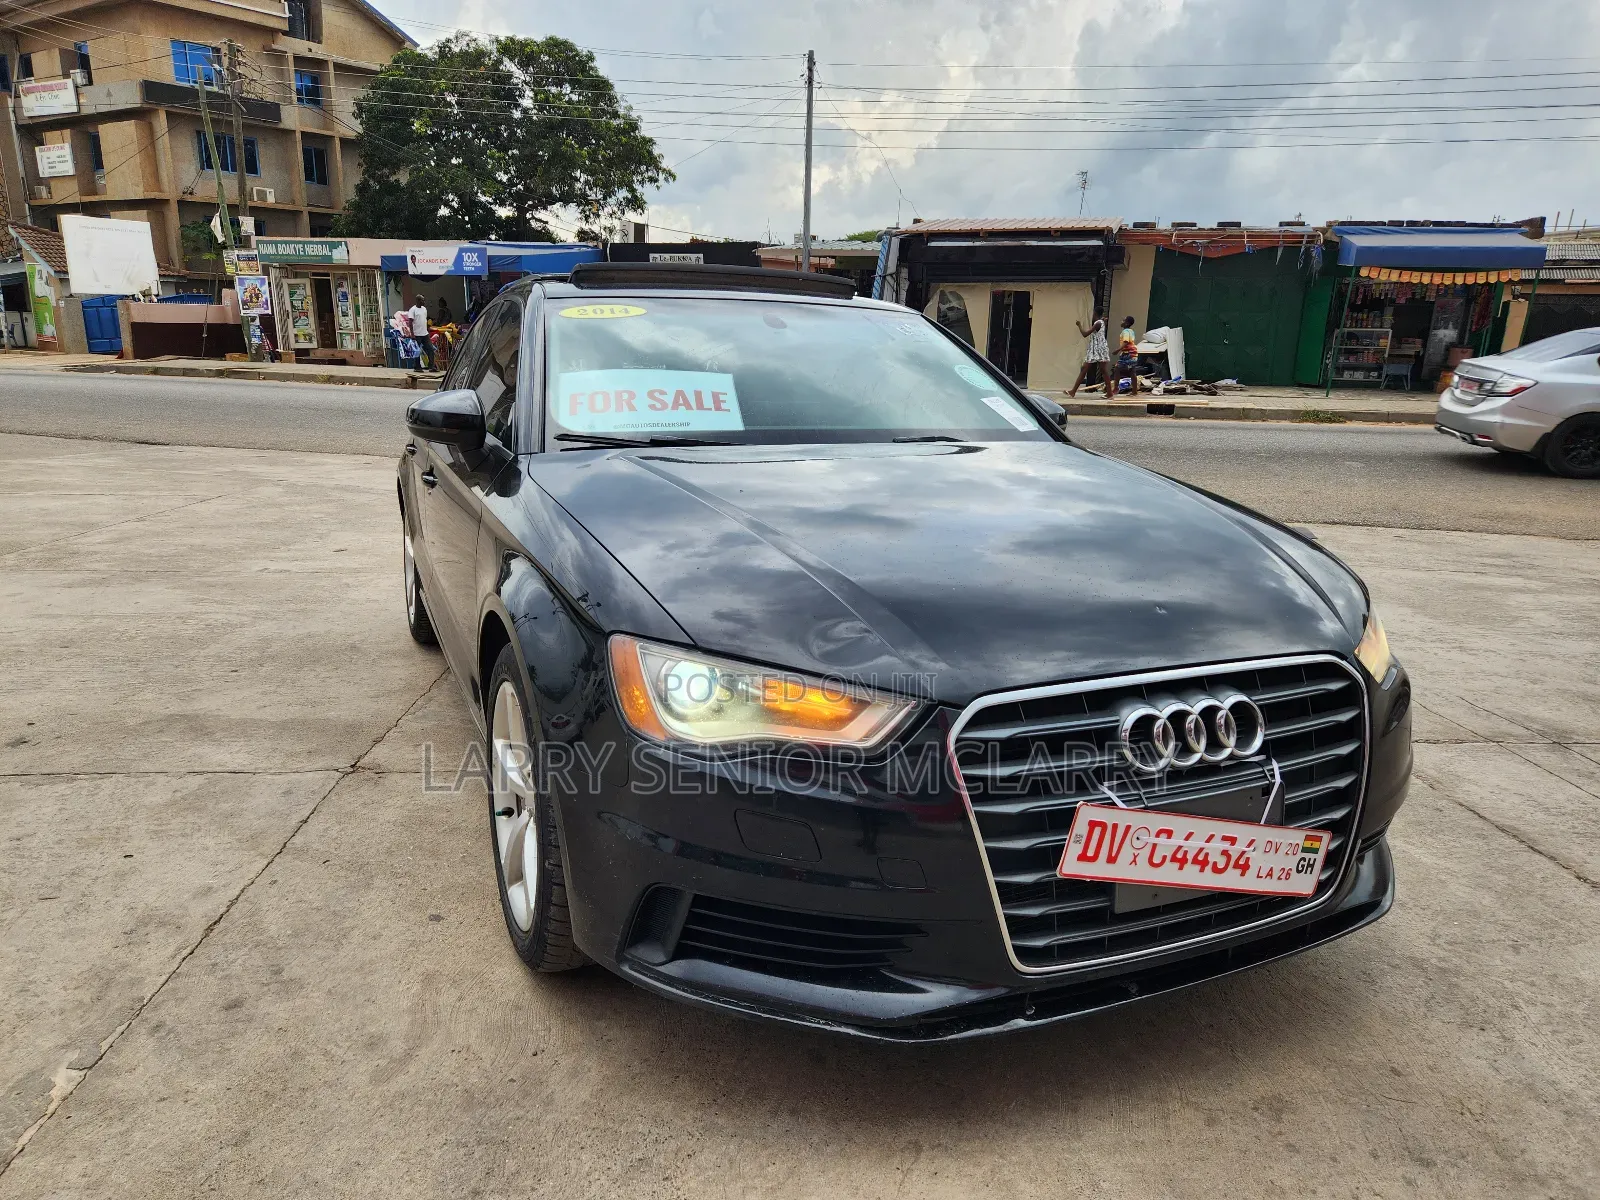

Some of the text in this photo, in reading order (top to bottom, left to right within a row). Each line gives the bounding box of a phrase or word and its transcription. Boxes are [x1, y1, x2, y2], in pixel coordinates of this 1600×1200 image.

[259, 243, 277, 255] NANA
[277, 243, 305, 255] BOAKYE
[462, 252, 479, 262] 10X
[577, 307, 631, 316] 2014
[568, 388, 731, 416] FOR SALE
[1076, 818, 1132, 866] DV
[1263, 840, 1300, 857] DV 20
[1256, 865, 1293, 882] LA 26
[1295, 856, 1317, 876] GH
